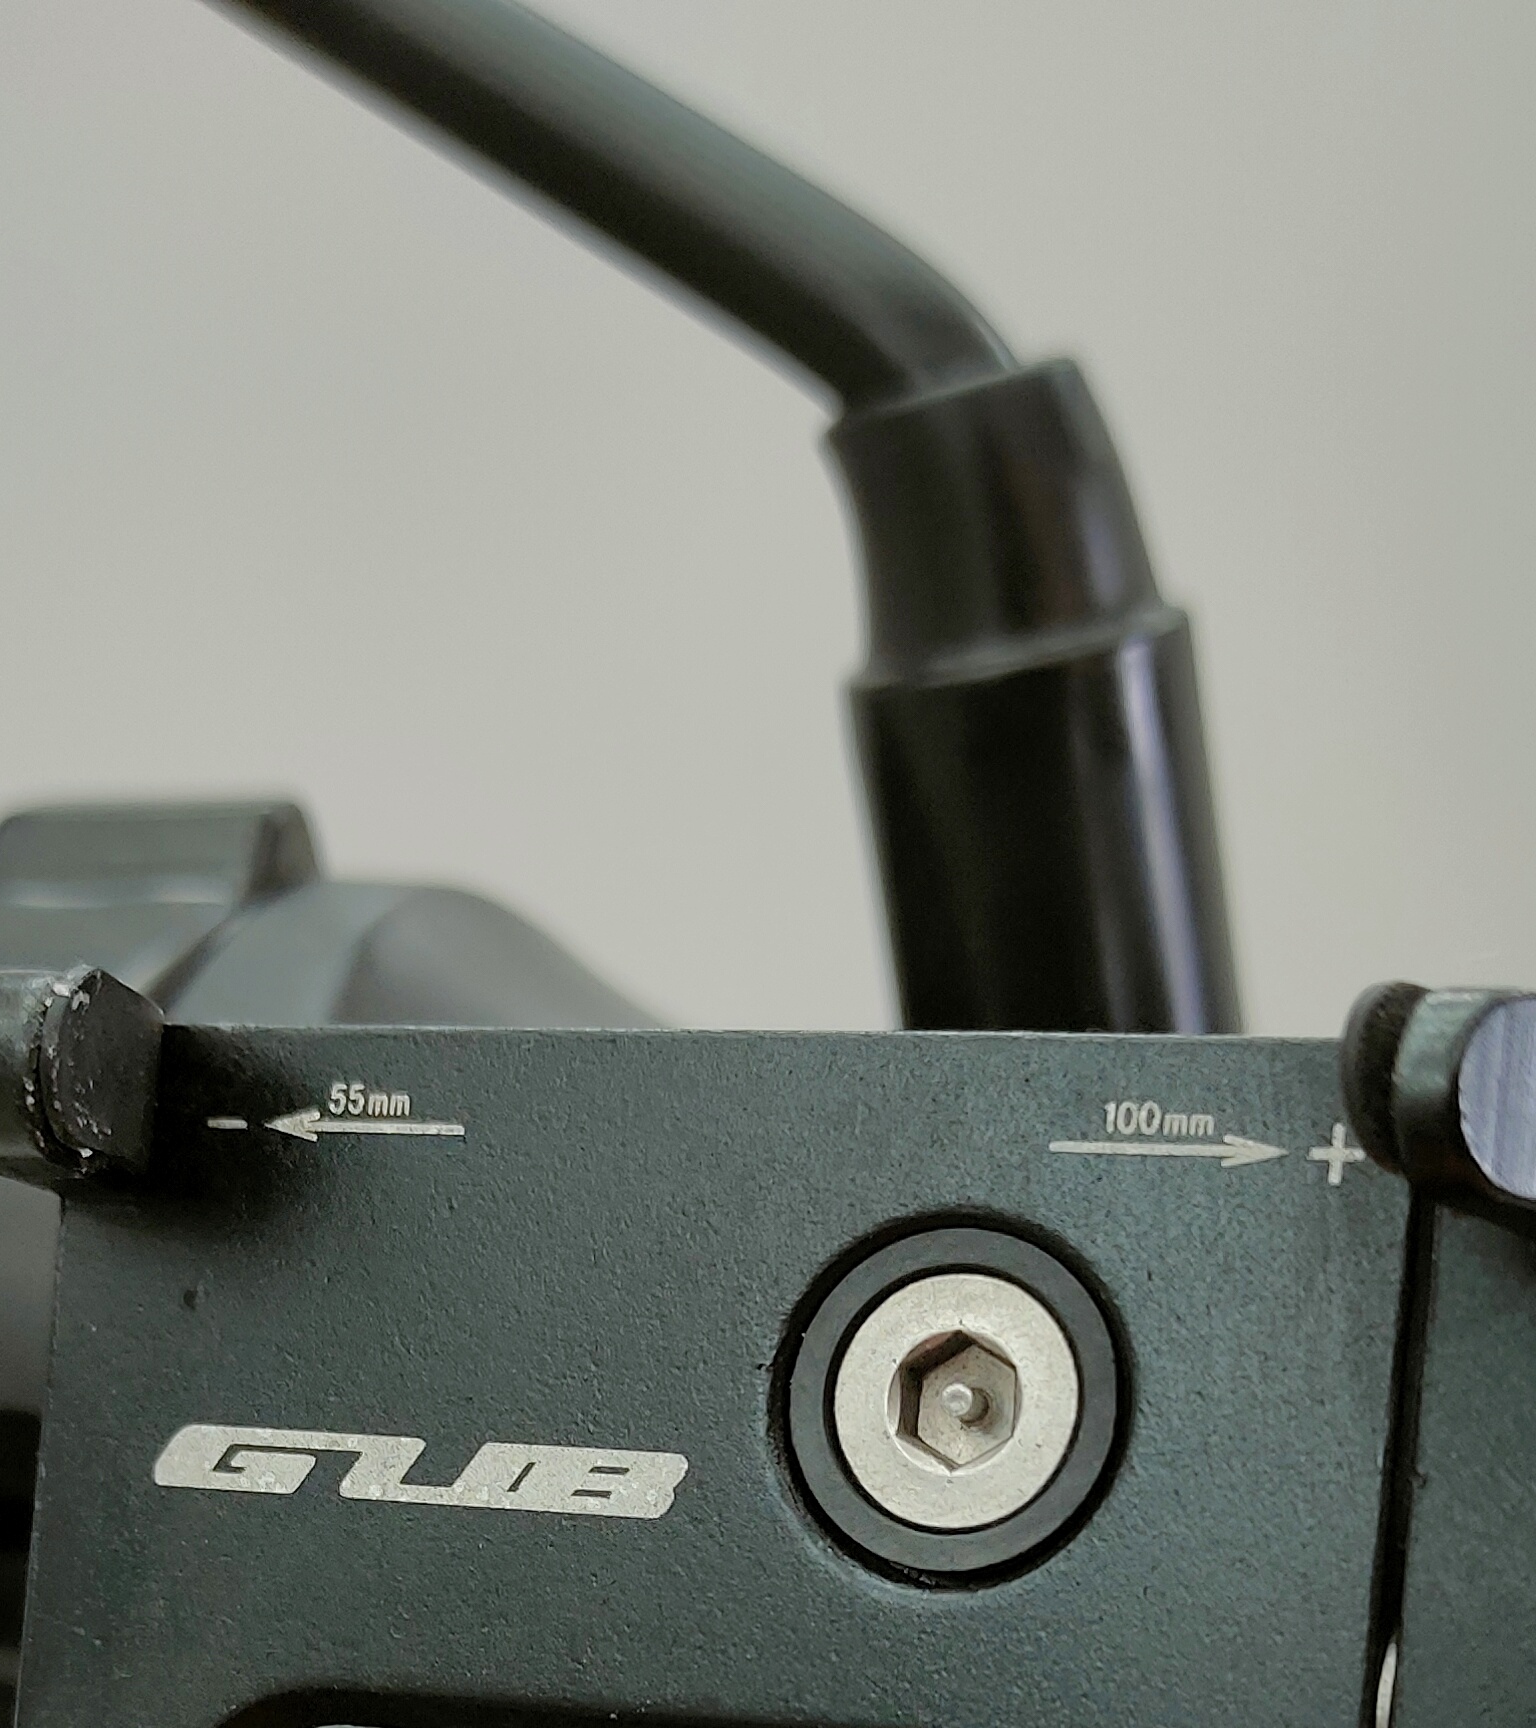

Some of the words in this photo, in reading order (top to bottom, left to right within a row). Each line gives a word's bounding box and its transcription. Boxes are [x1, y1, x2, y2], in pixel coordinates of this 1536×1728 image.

[327, 1081, 412, 1117] 55mm
[1104, 1100, 1215, 1136] 100mm
[152, 1423, 690, 1521] GUB
